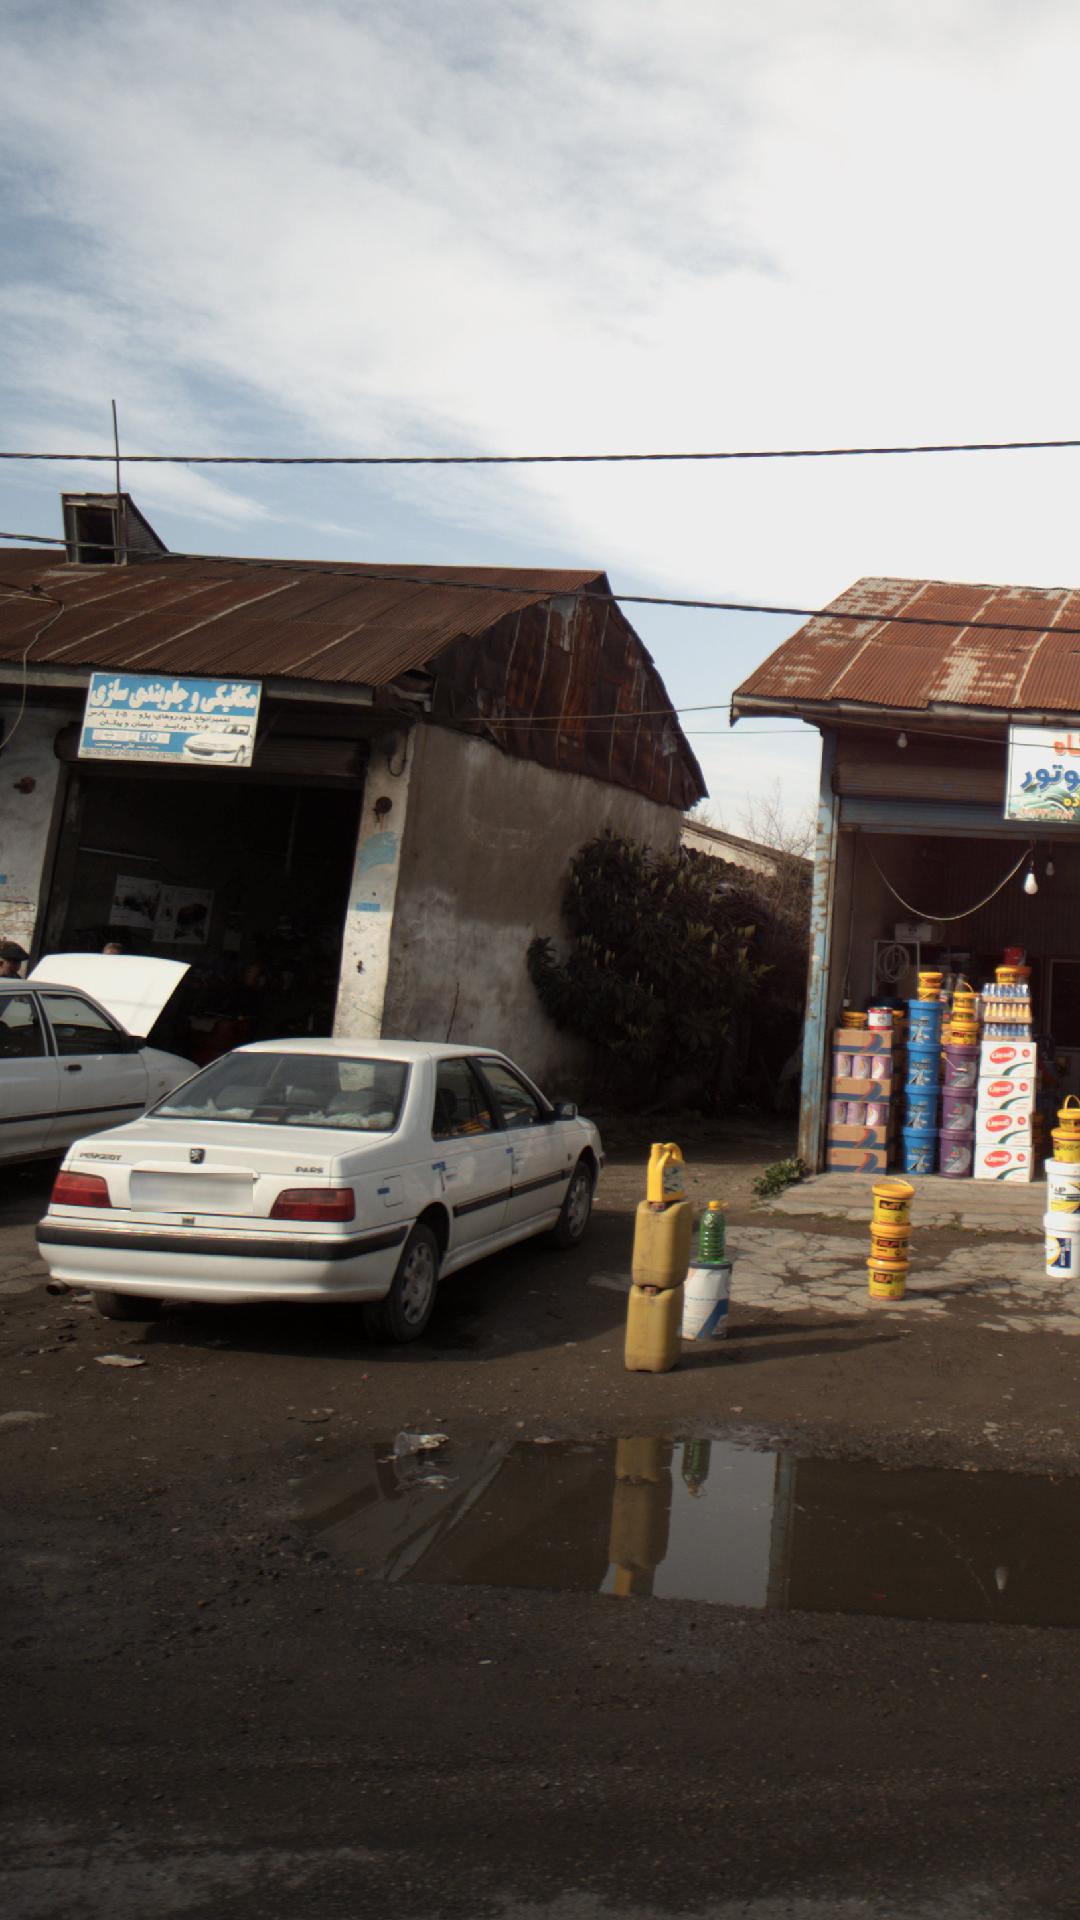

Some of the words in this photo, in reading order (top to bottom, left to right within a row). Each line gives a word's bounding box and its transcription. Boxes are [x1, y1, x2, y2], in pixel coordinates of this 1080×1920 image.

[90, 678, 129, 707] سازی
[129, 680, 189, 711] جلوبندی
[188, 691, 200, 712] و
[200, 684, 257, 713] مکانیکی
[295, 1165, 324, 1175] PARS
